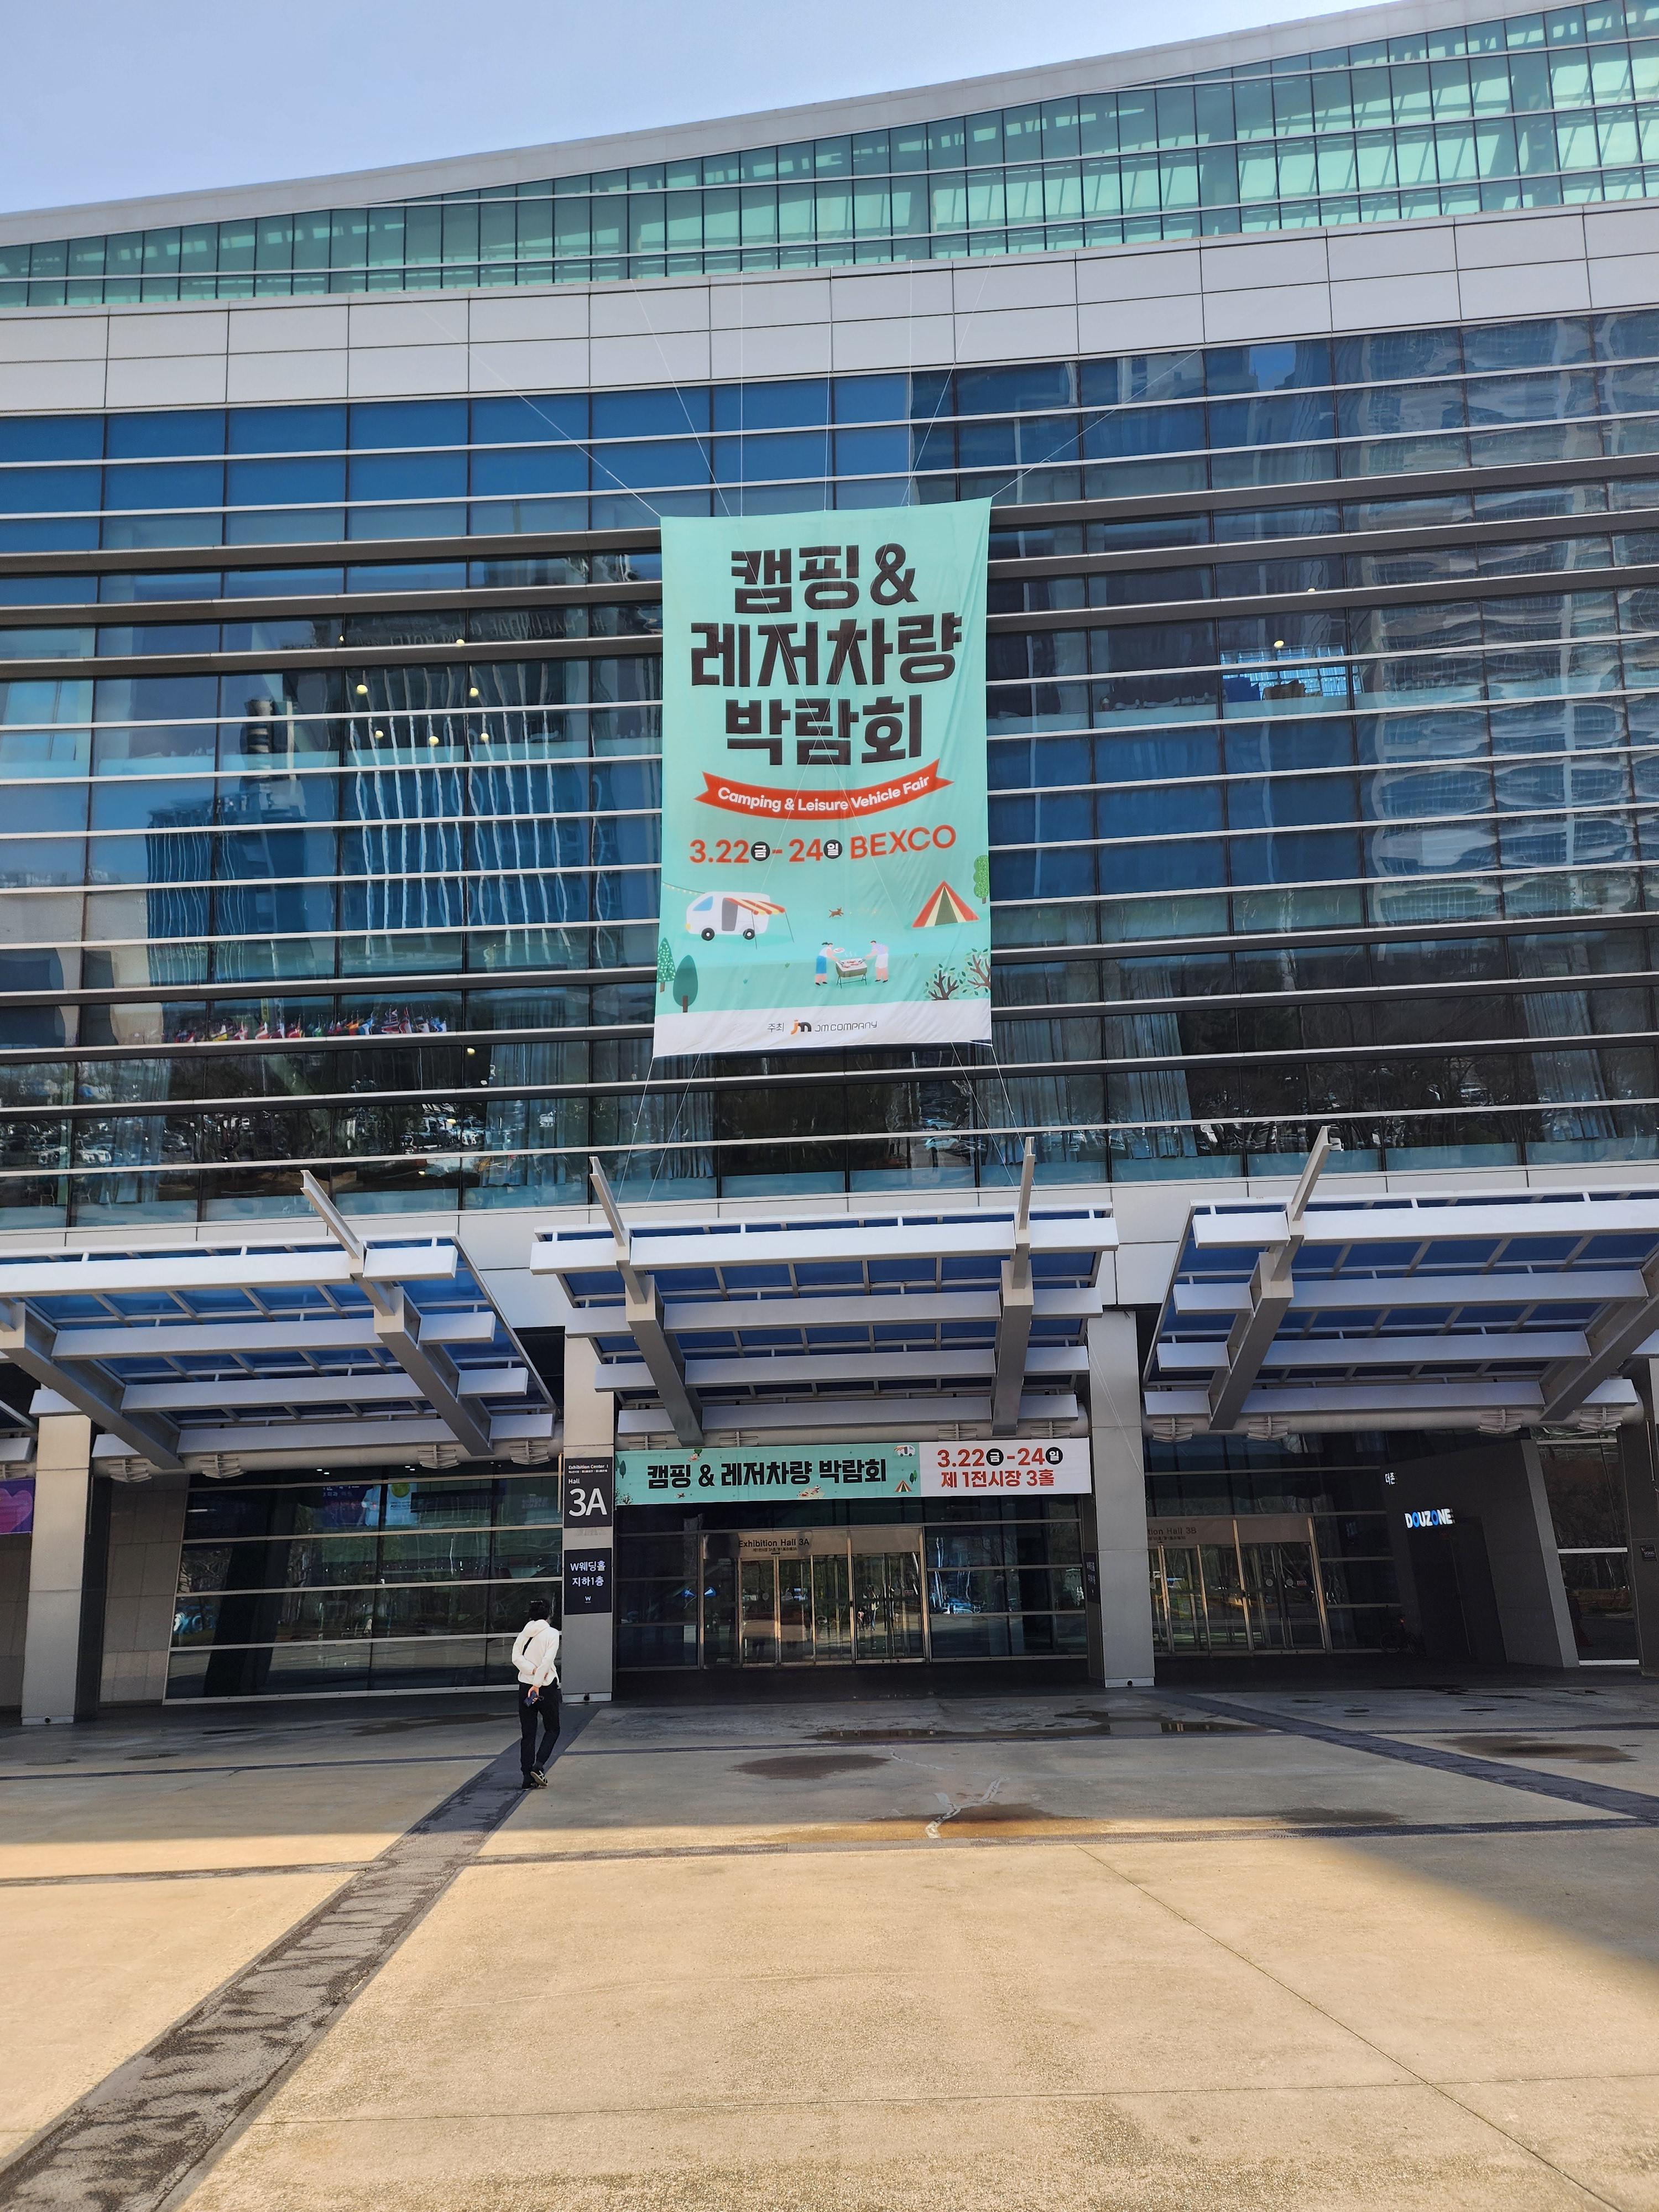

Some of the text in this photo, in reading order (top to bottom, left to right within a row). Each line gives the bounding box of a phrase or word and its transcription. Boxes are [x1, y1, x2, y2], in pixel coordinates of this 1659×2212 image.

[691, 612, 962, 687] 레저차량
[725, 694, 922, 765] 박람회
[718, 776, 930, 812] Camping & Leisure Vehicle Fair
[850, 824, 956, 860] BEXCO
[767, 1022, 784, 1032] 주최
[647, 1459, 886, 1489] 캠핑 & 레저차량 박람회
[1026, 1469, 1054, 1486] 3홀
[568, 1488, 608, 1516] 3A
[1404, 1508, 1453, 1528] DOUZONE
[738, 1539, 778, 1548] Exhibition
[799, 1538, 810, 1546] 3A
[572, 1575, 604, 1587] 지하1층
